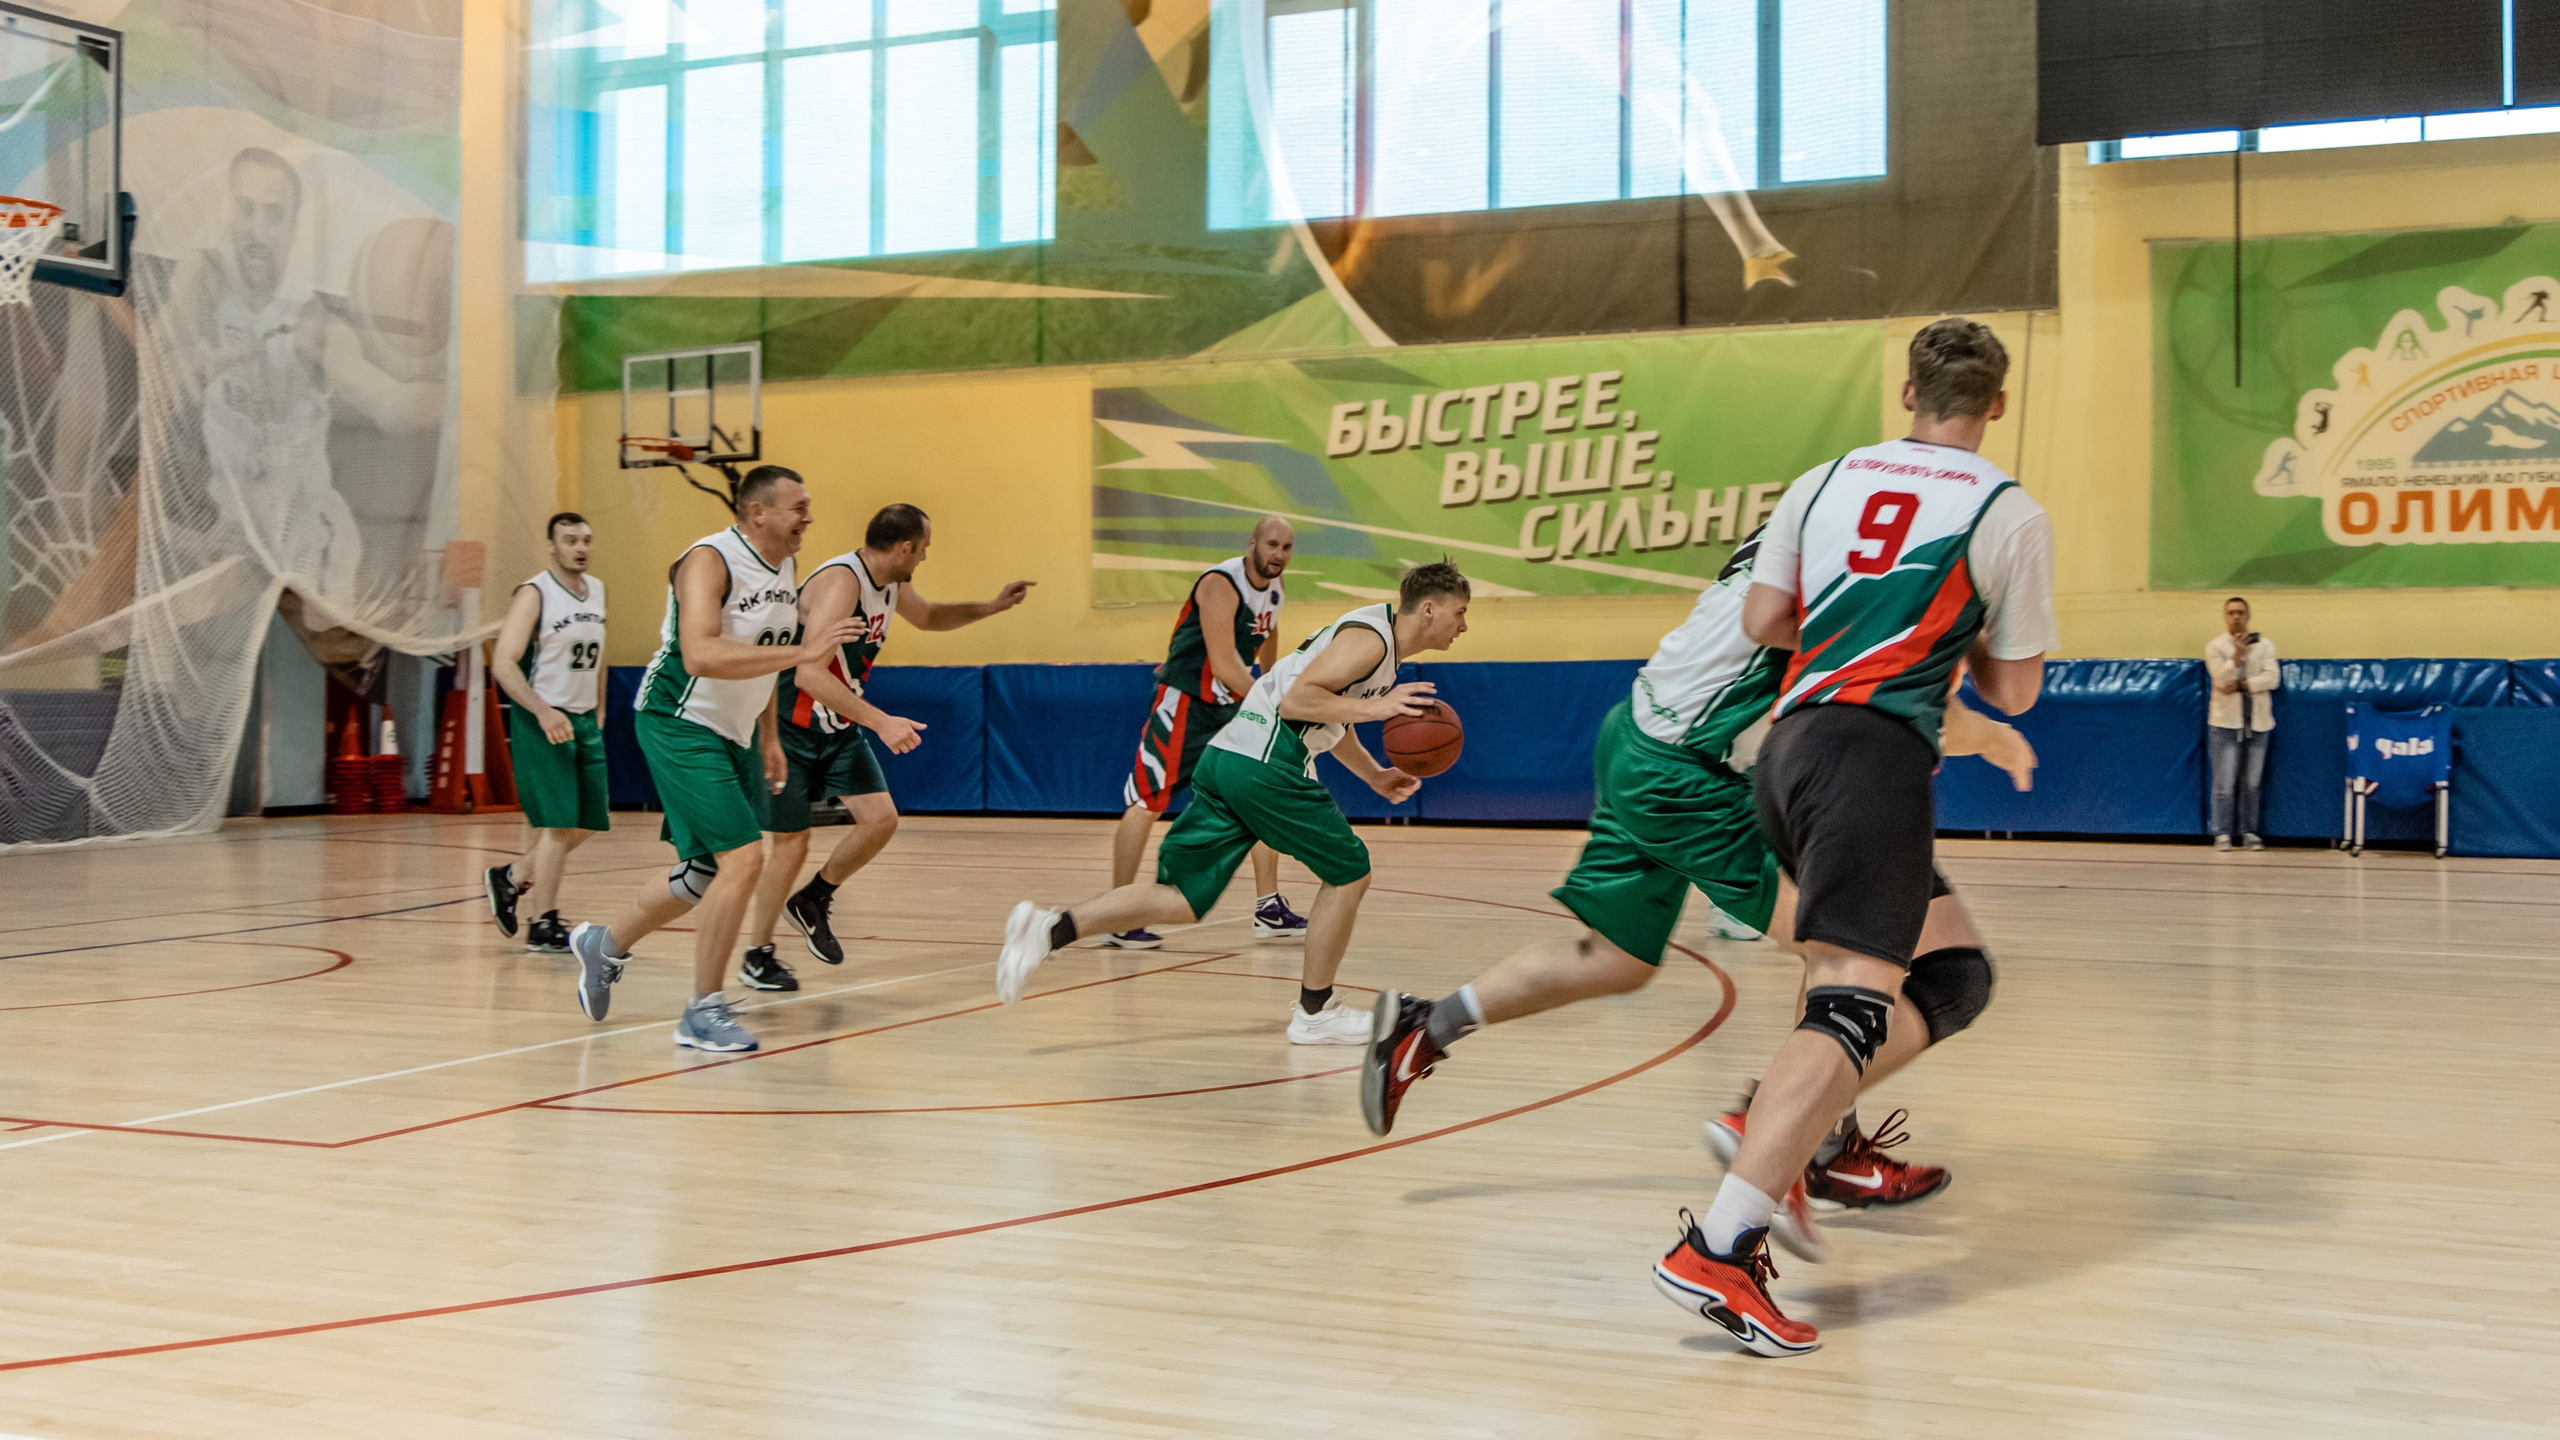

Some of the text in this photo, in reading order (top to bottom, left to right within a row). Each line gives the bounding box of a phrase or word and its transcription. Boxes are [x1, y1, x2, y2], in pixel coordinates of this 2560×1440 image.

[1326, 370, 1638, 459] БЫСТРЕЕ,
[2390, 364, 2539, 432] СПОРТИВНАЯ
[1440, 430, 1675, 508] ВЫШЕ,
[1519, 481, 1794, 562] СИЛЬНЕ
[1847, 489, 1922, 576] 9
[2338, 487, 2560, 535] ОЛИМ
[739, 592, 760, 613] НК
[570, 640, 600, 671] 29
